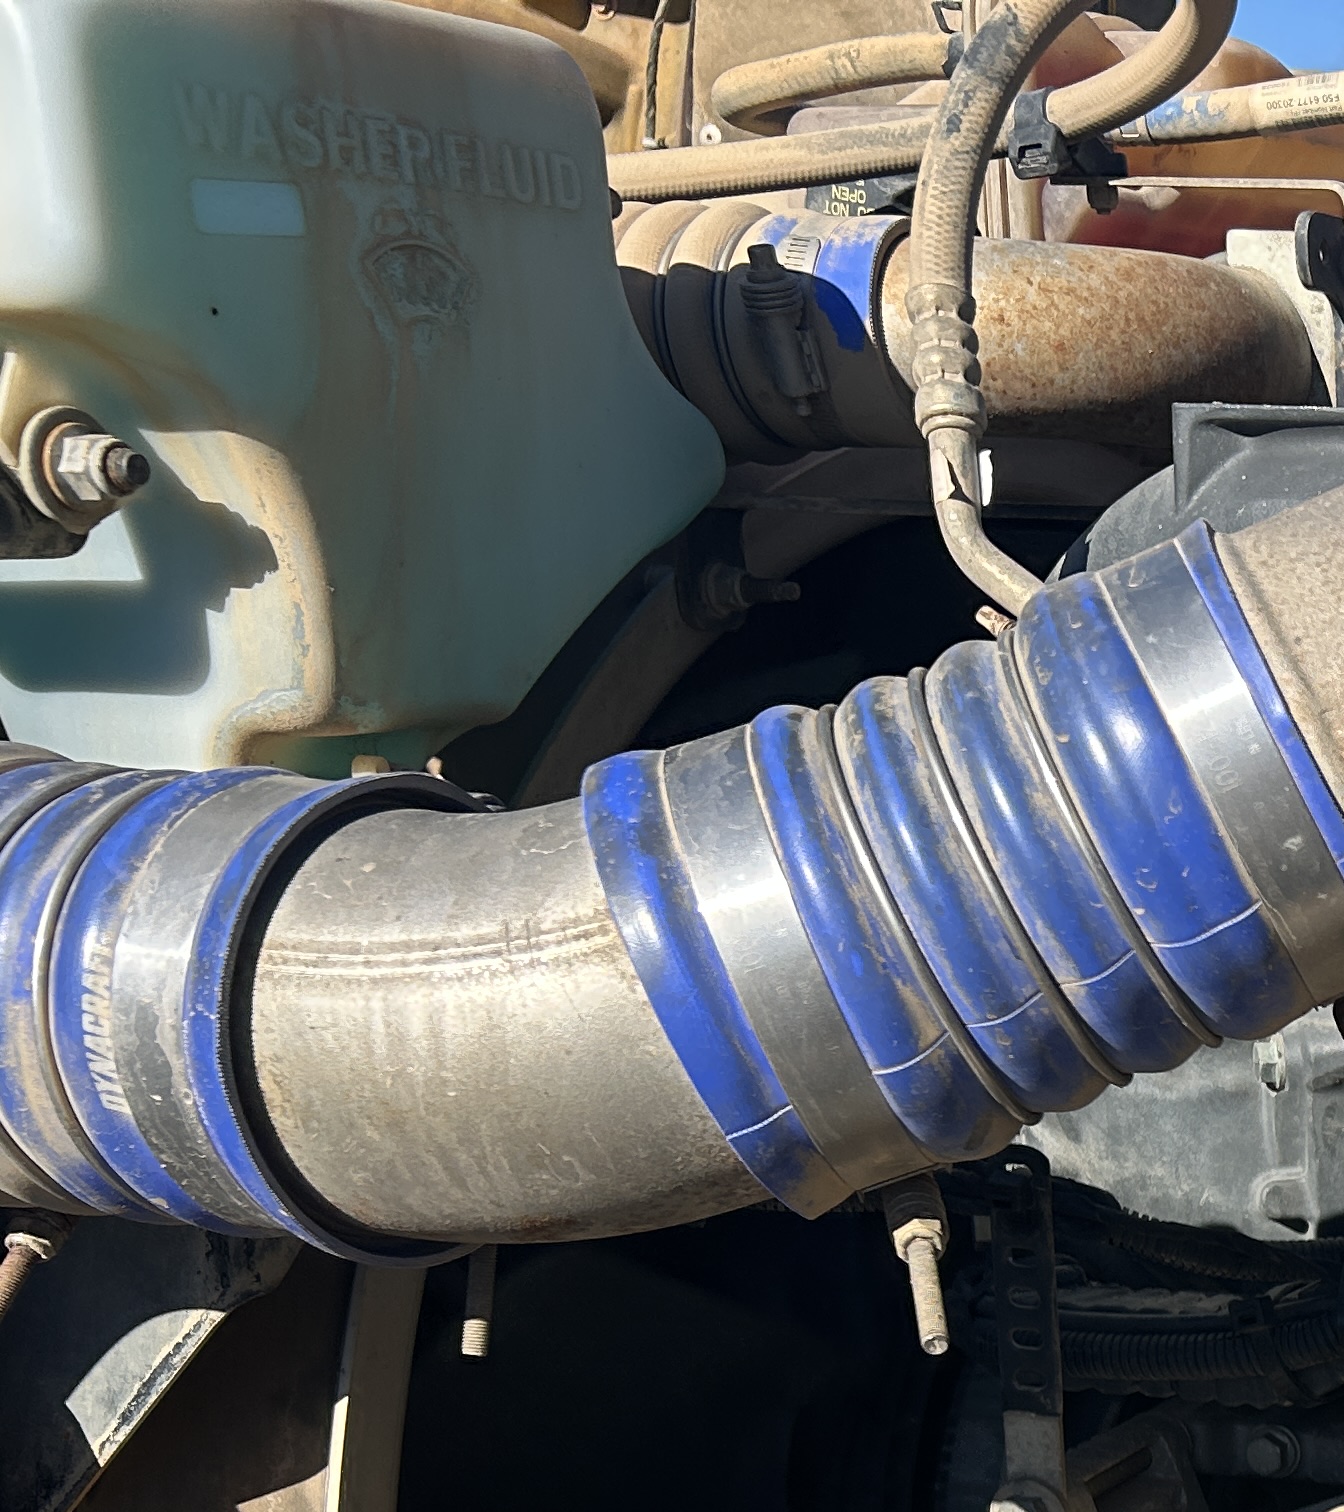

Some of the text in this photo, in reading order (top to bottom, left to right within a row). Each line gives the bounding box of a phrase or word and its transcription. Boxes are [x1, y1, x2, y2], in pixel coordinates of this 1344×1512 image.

[180, 80, 582, 211] WASHER FLUID
[823, 200, 849, 217] NOT
[831, 184, 866, 204] OPEN
[81, 942, 130, 1114] DYNACRAFT
